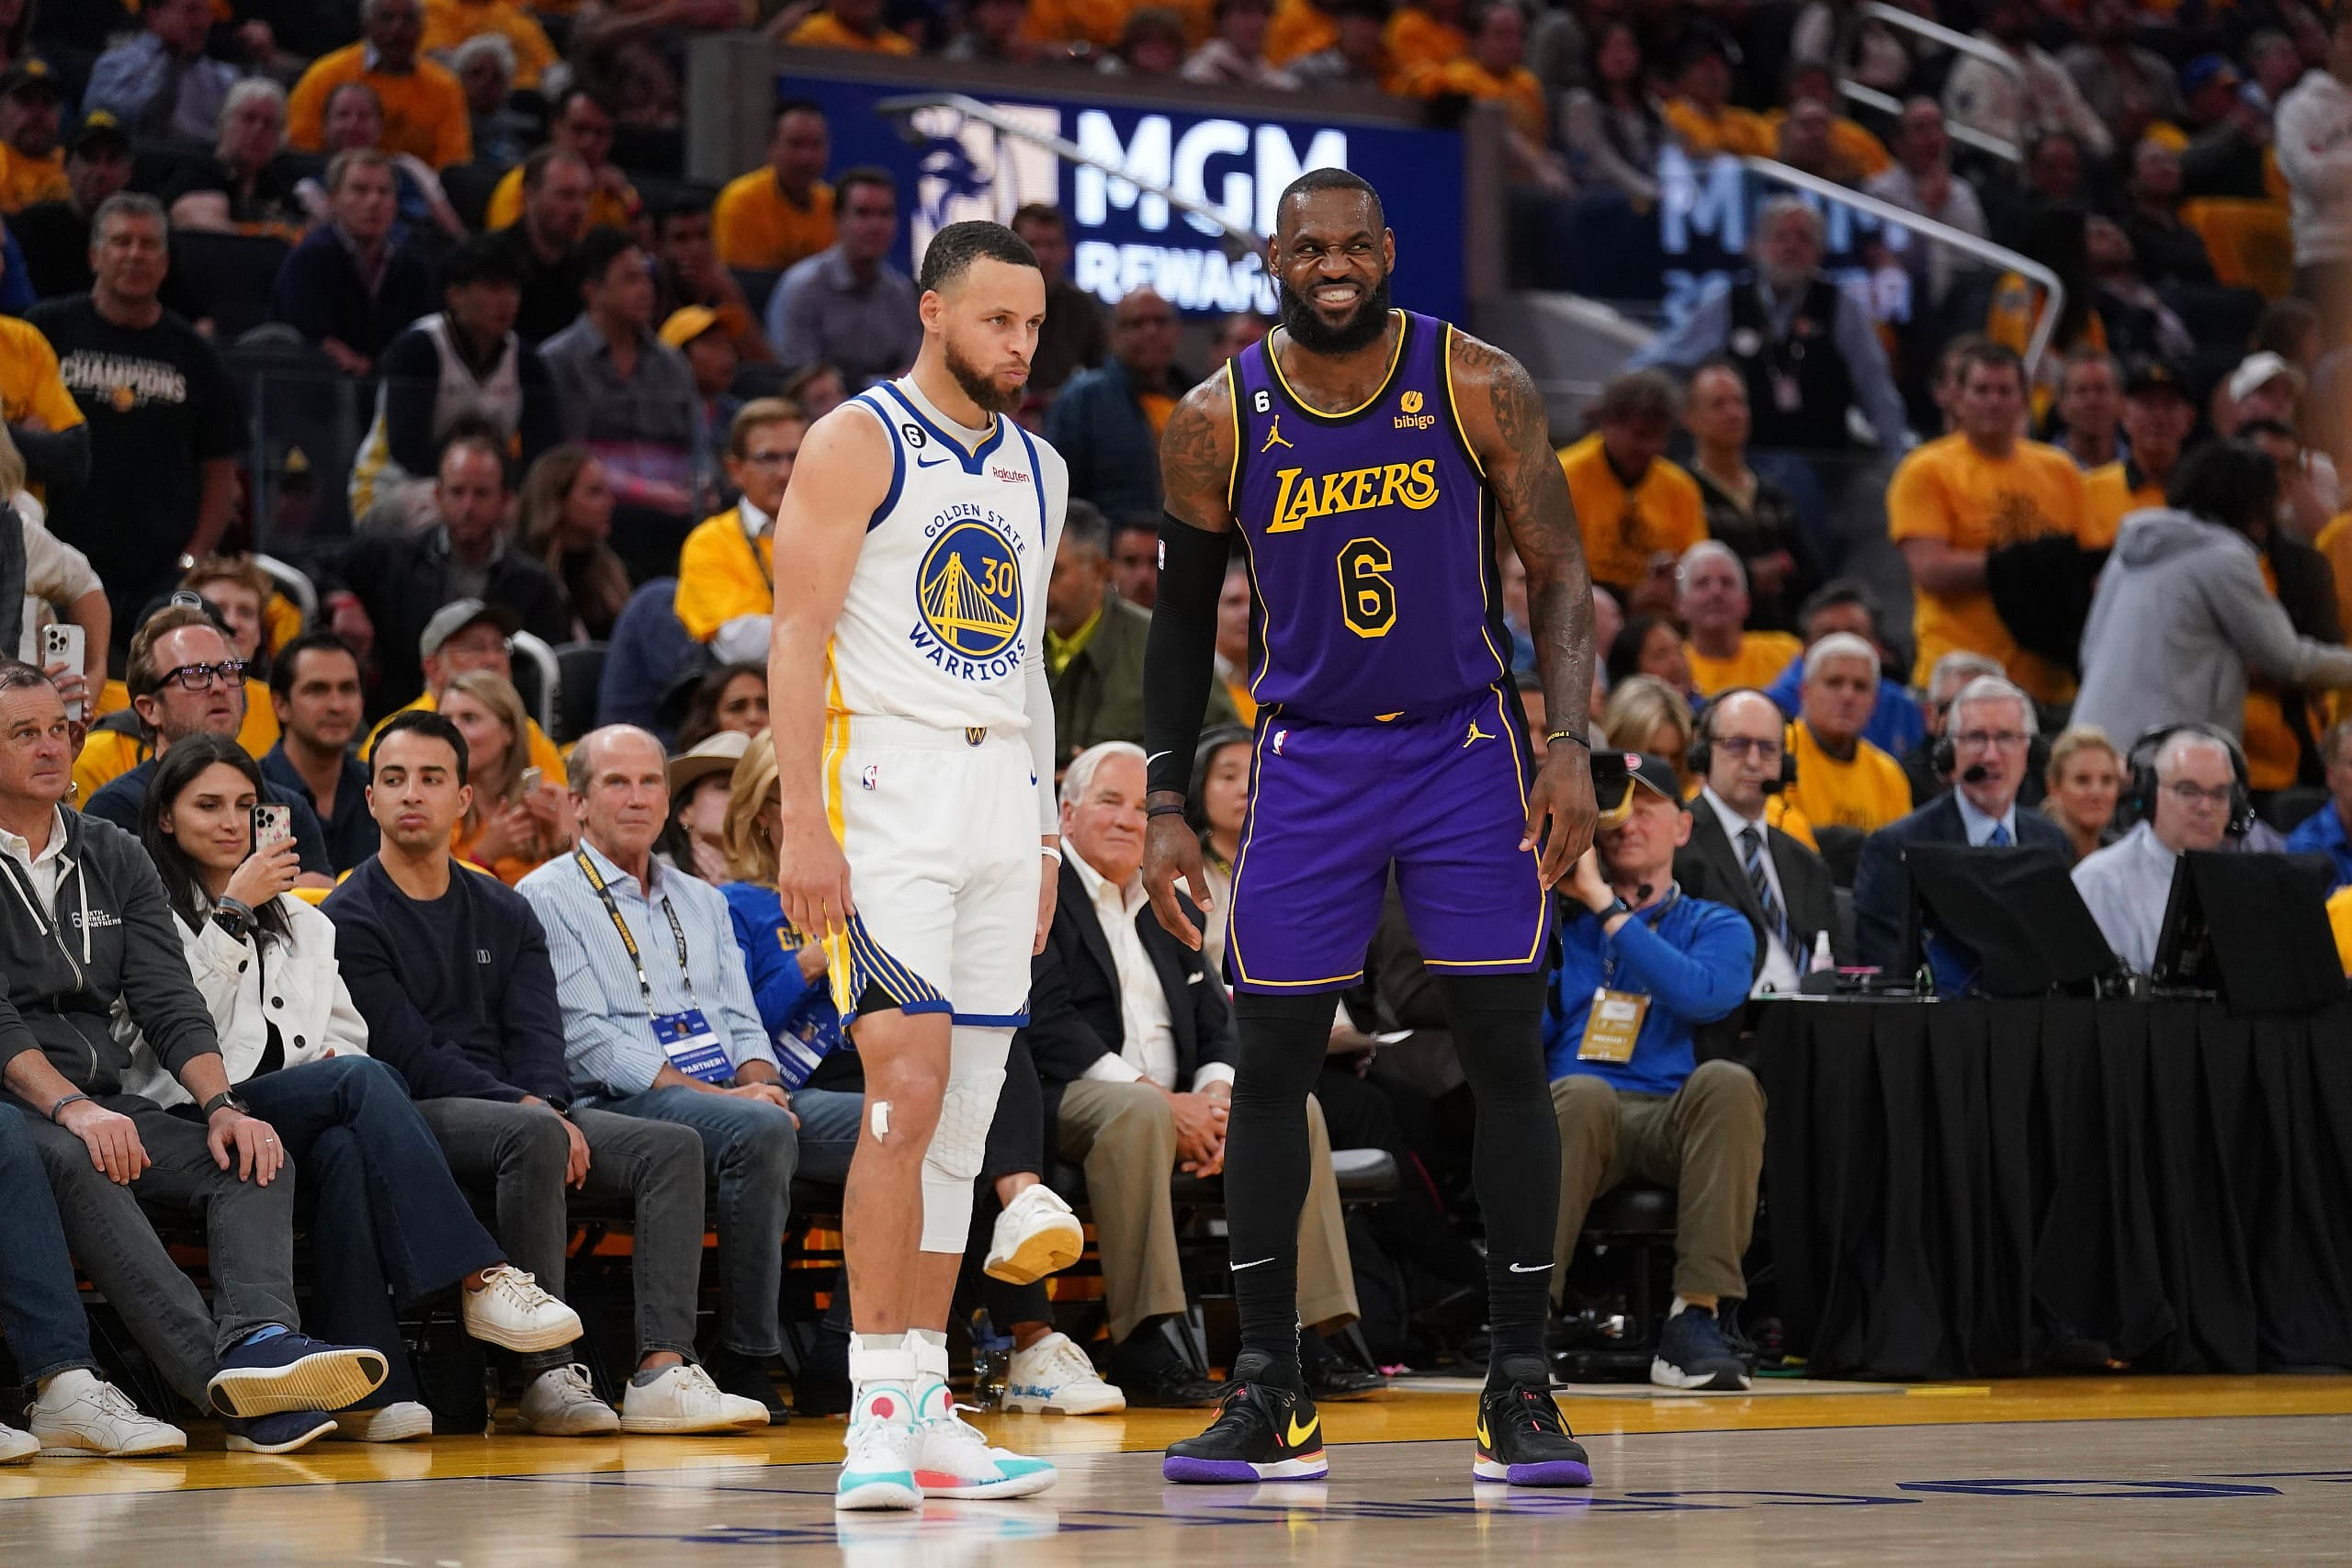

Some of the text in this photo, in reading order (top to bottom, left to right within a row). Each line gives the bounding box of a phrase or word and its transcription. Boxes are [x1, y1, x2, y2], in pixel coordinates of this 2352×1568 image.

[1074, 108, 1347, 240] MGM
[60, 355, 187, 403] CHAMPIONS
[1254, 390, 1271, 413] 6
[1394, 414, 1435, 430] bibigo
[992, 466, 1031, 483] Rakuten
[1265, 459, 1440, 534] LAKERS
[924, 503, 1025, 555] GOLDEN STATE
[981, 557, 1013, 598] 30
[1337, 536, 1397, 638] 6
[909, 621, 1026, 682] WARRIORS
